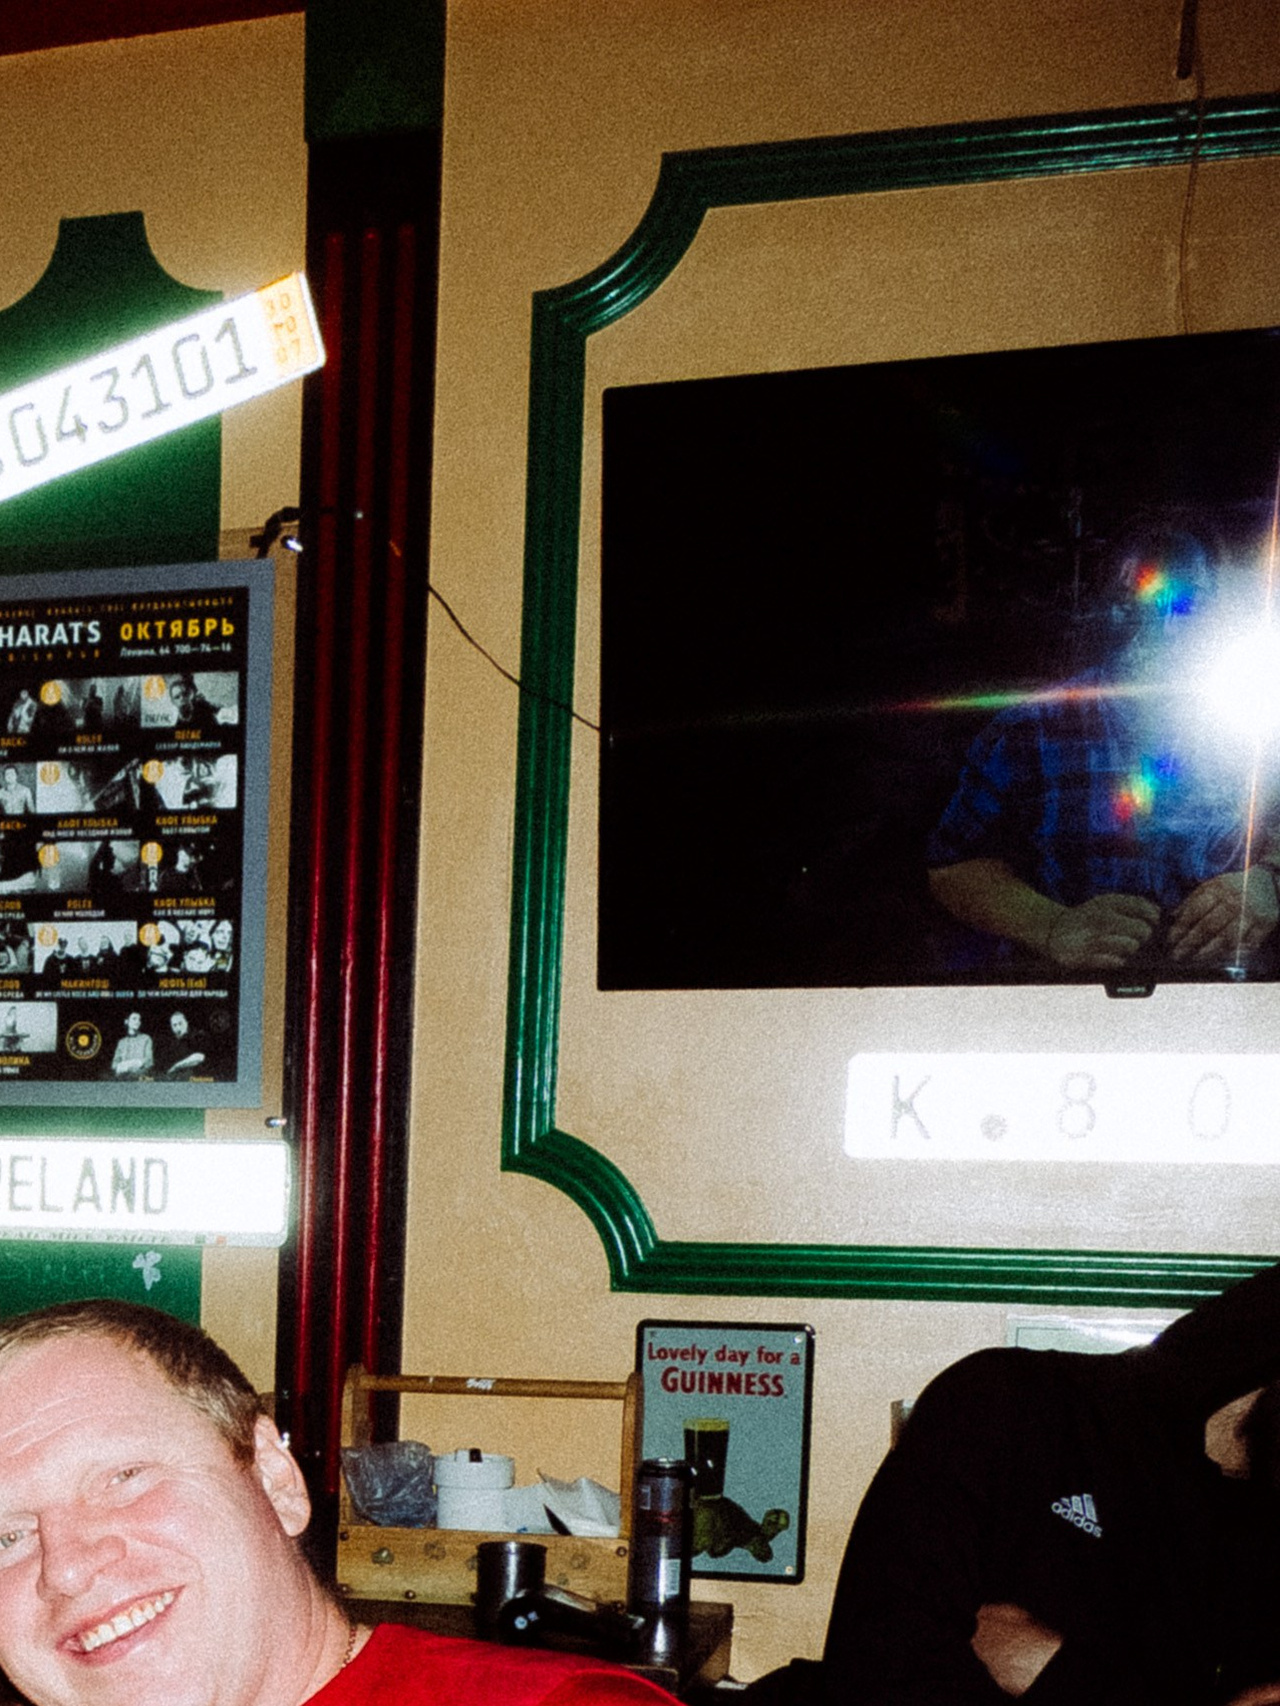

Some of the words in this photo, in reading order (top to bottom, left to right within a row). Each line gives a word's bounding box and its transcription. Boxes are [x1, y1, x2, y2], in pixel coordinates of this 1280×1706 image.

[120, 618, 234, 641] ОКТЯБРЬ
[648, 1342, 707, 1365] Lovely
[715, 1344, 750, 1367] day
[757, 1346, 784, 1364] for
[790, 1352, 801, 1365] a
[661, 1366, 785, 1397] GUINNESS
[1051, 1502, 1103, 1538] adidas
